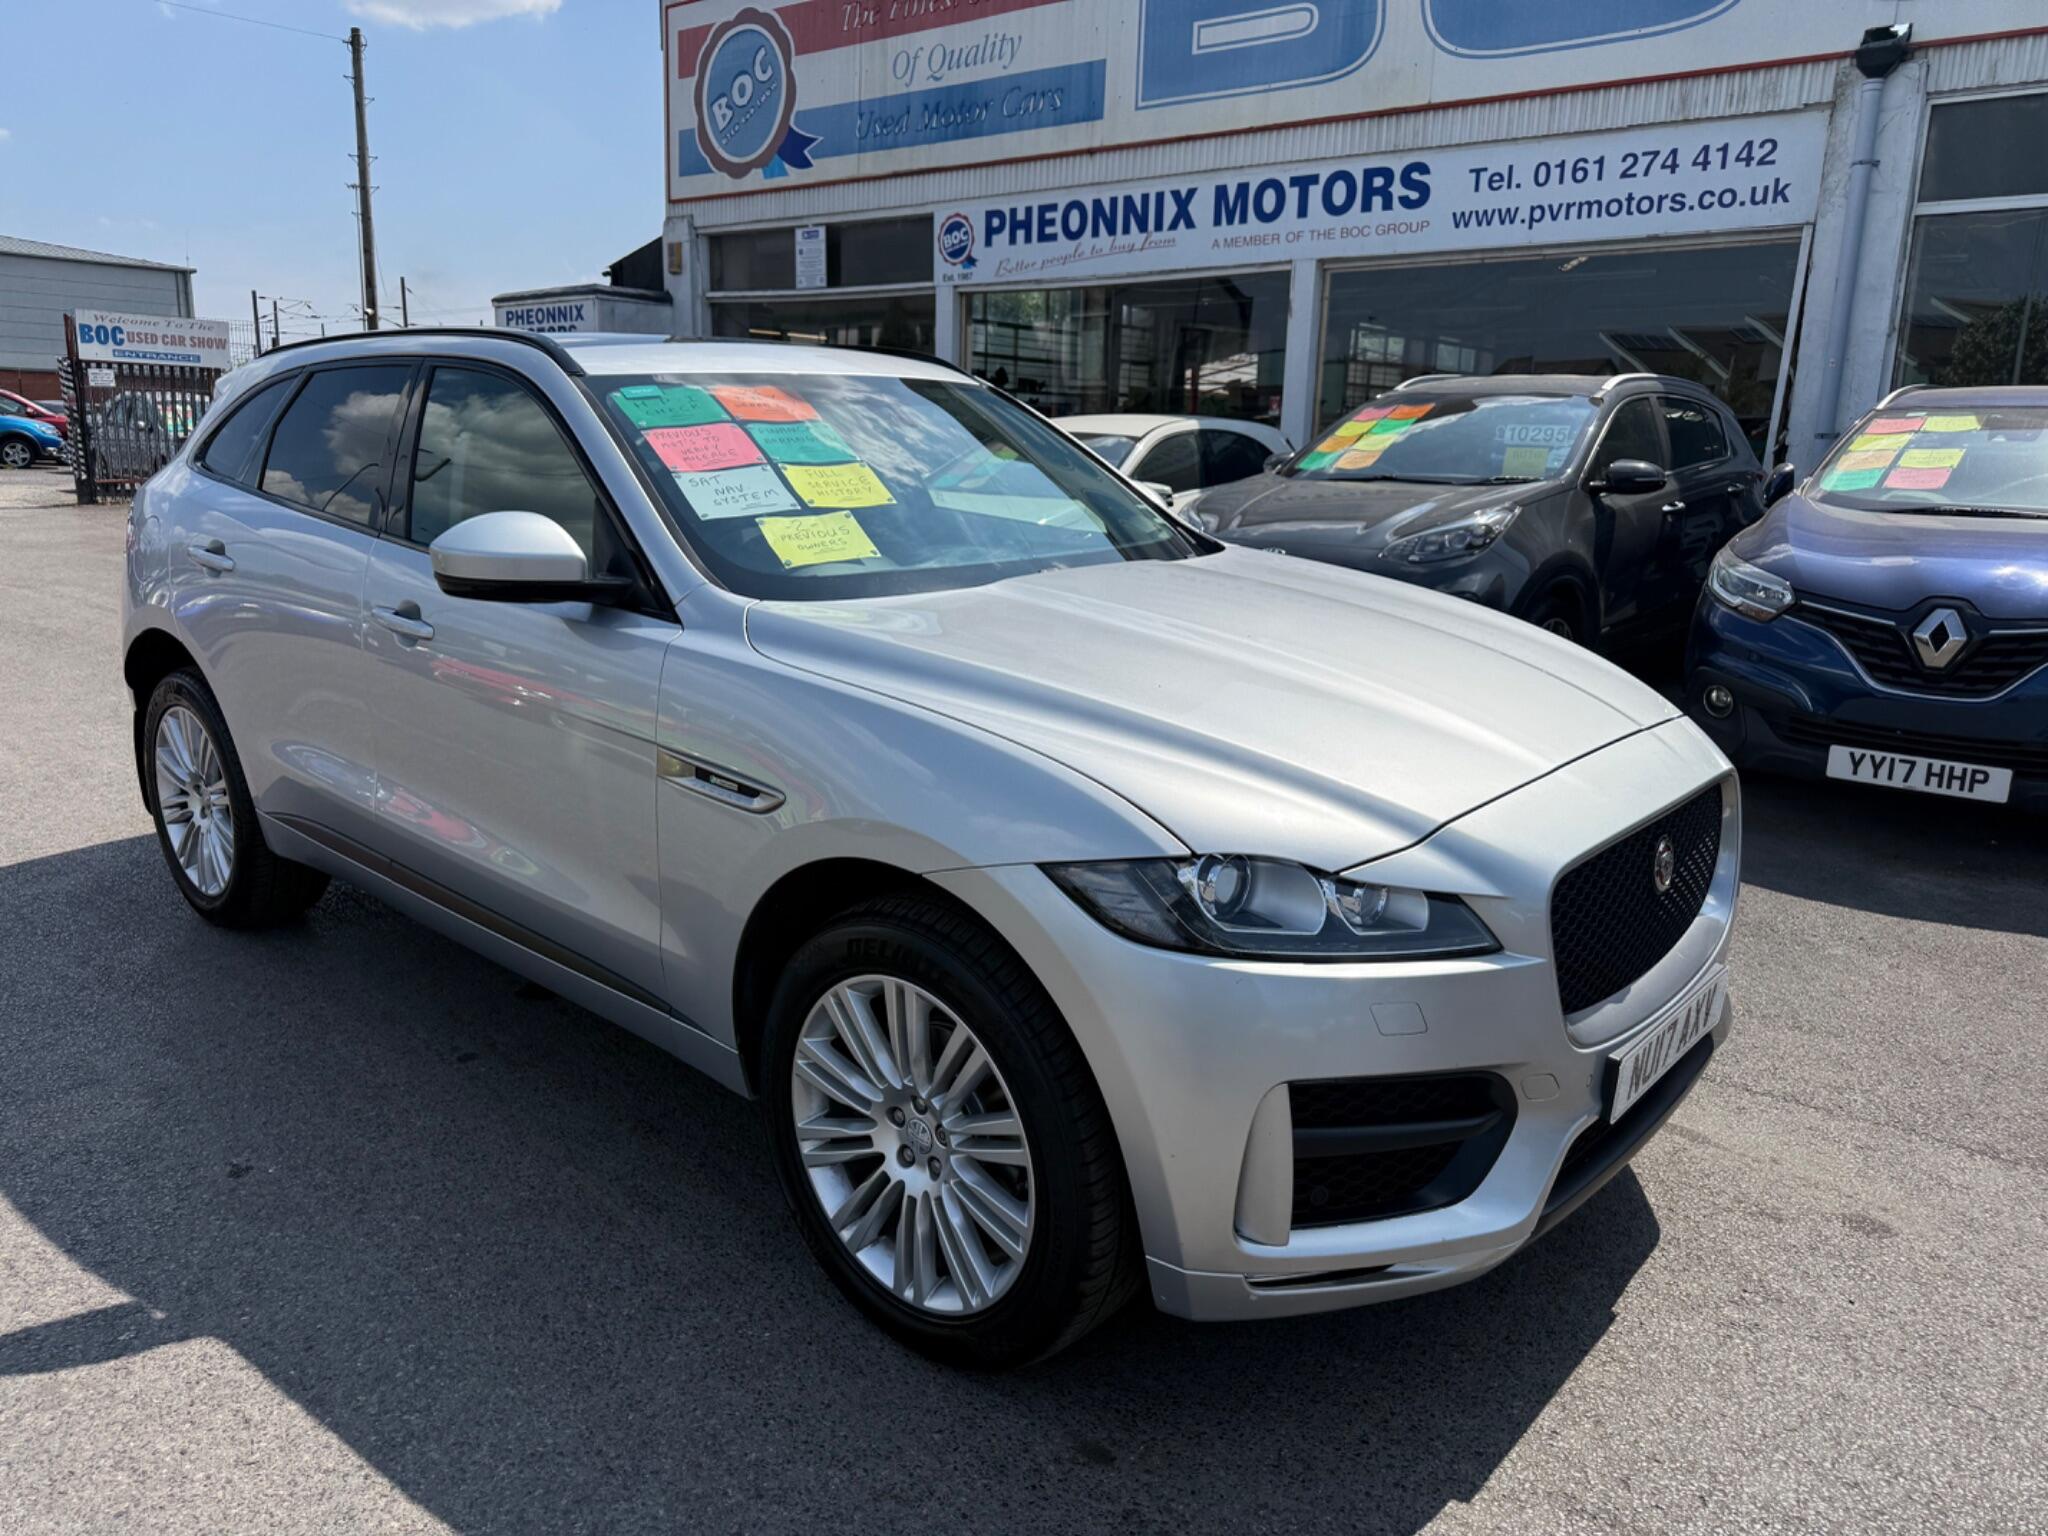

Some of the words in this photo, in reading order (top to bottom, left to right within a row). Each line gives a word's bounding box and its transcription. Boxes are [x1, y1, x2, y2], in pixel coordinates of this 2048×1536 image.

[841, 1, 879, 31] The
[892, 46, 923, 88] Of
[926, 32, 1022, 81] Quality
[711, 45, 774, 133] BOC
[855, 105, 911, 140] Used
[916, 100, 995, 132] Motor
[1002, 85, 1065, 118] Cars
[1469, 164, 1522, 193] Tel.
[1533, 155, 1605, 187] 0161
[1619, 147, 1680, 180] 274
[1691, 138, 1778, 172] 4142
[984, 187, 1198, 248] PHEONNIX
[1212, 161, 1432, 228] MOTORS
[1452, 177, 1792, 230] www.pvrmotors.co.uk
[944, 227, 969, 249] BOC
[1211, 238, 1220, 249] A
[1222, 232, 1281, 248] MEMBER
[1285, 230, 1305, 243] OF
[1309, 227, 1336, 241] THE
[1340, 225, 1371, 239] BOC
[1375, 220, 1431, 236] GROUP
[993, 258, 1037, 278] Better
[1040, 242, 1085, 270] people
[1090, 245, 1103, 256] to
[1108, 237, 1135, 253] buy
[1139, 231, 1177, 253] from
[93, 314, 160, 329] Welcome
[164, 319, 184, 329] To
[188, 321, 215, 332] The
[505, 304, 585, 327] PHEONNIX
[78, 323, 126, 347] BOC
[126, 331, 159, 345] USED
[161, 333, 188, 348] CAR
[189, 336, 228, 350] SHOW
[114, 350, 201, 363] ENTRANCE
[688, 474, 722, 487] SAT
[714, 484, 744, 496] NAV
[713, 488, 780, 506] SYSTEM
[780, 526, 850, 542] PREVIOUS
[1848, 751, 1917, 784] YY17
[1923, 762, 1990, 794] HHP
[1627, 1017, 1679, 1102] NU17
